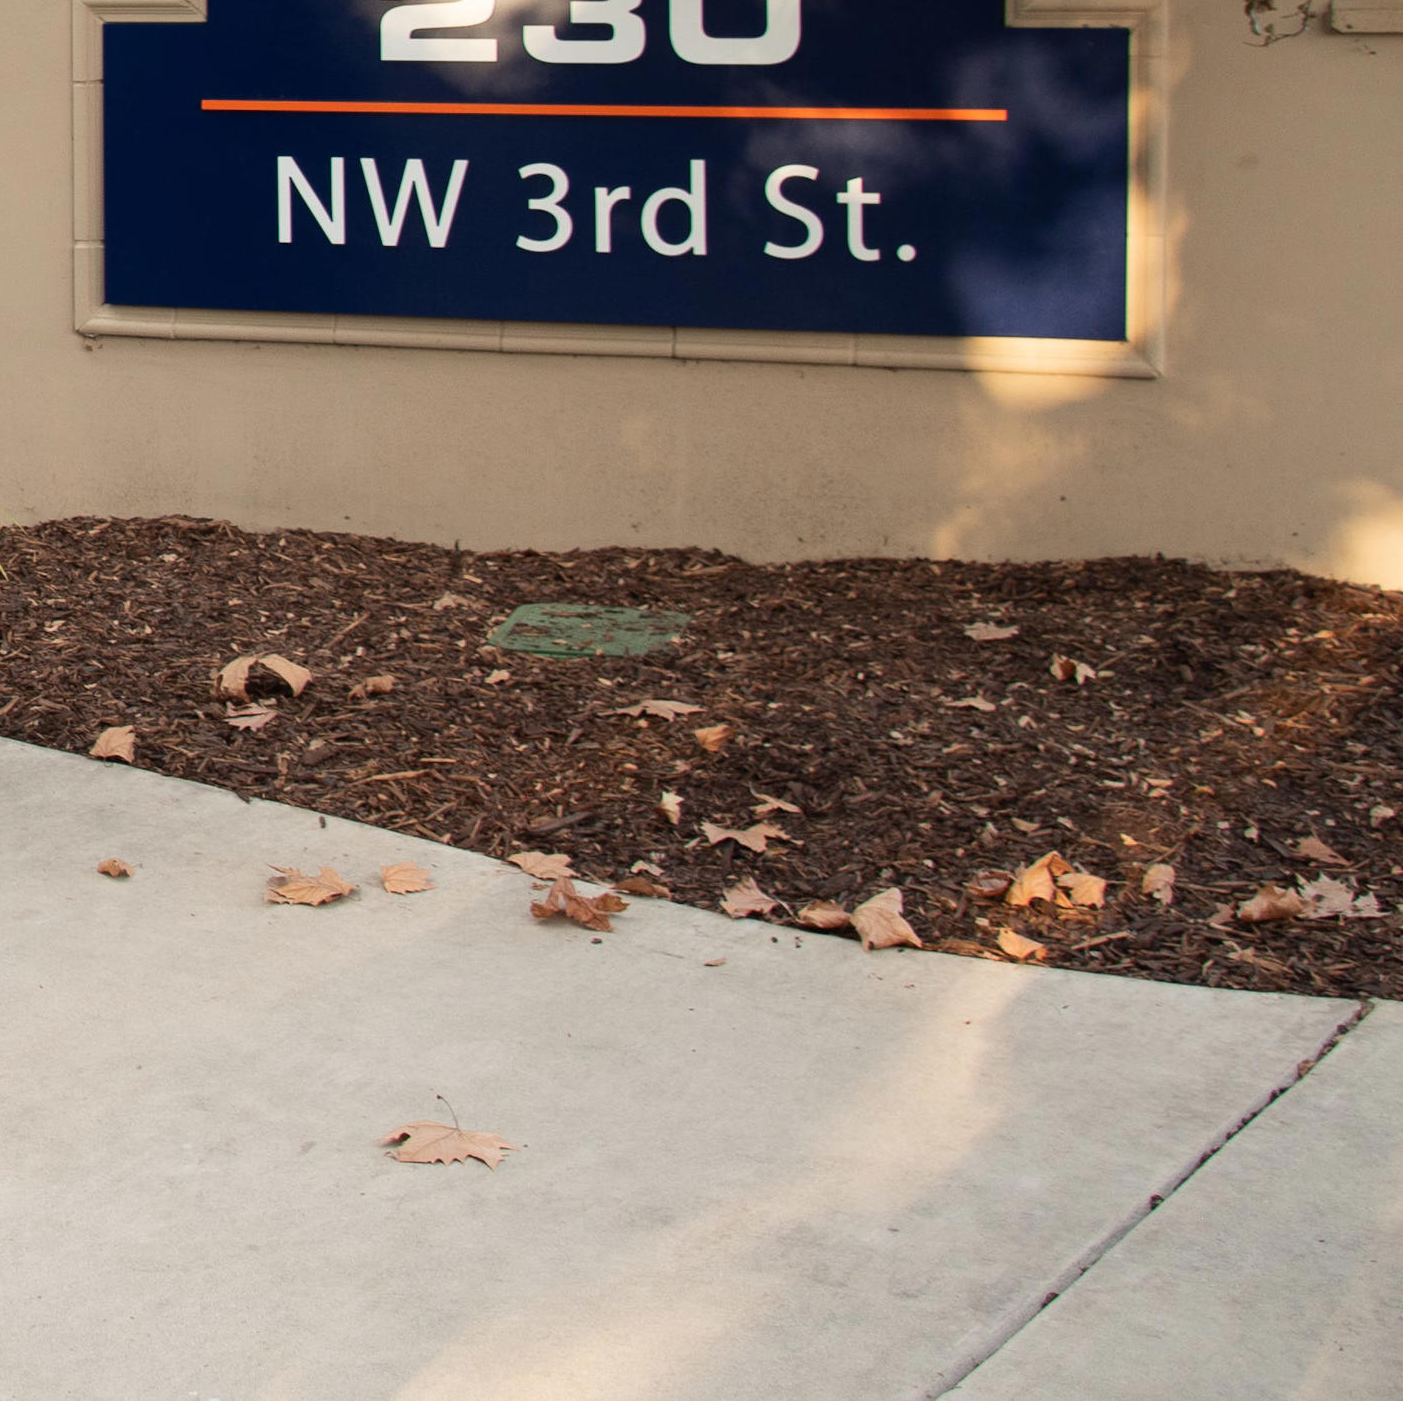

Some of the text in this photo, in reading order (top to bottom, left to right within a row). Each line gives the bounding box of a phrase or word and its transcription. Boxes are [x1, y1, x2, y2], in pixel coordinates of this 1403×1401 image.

[277, 155, 916, 262] NW 3rd St.
